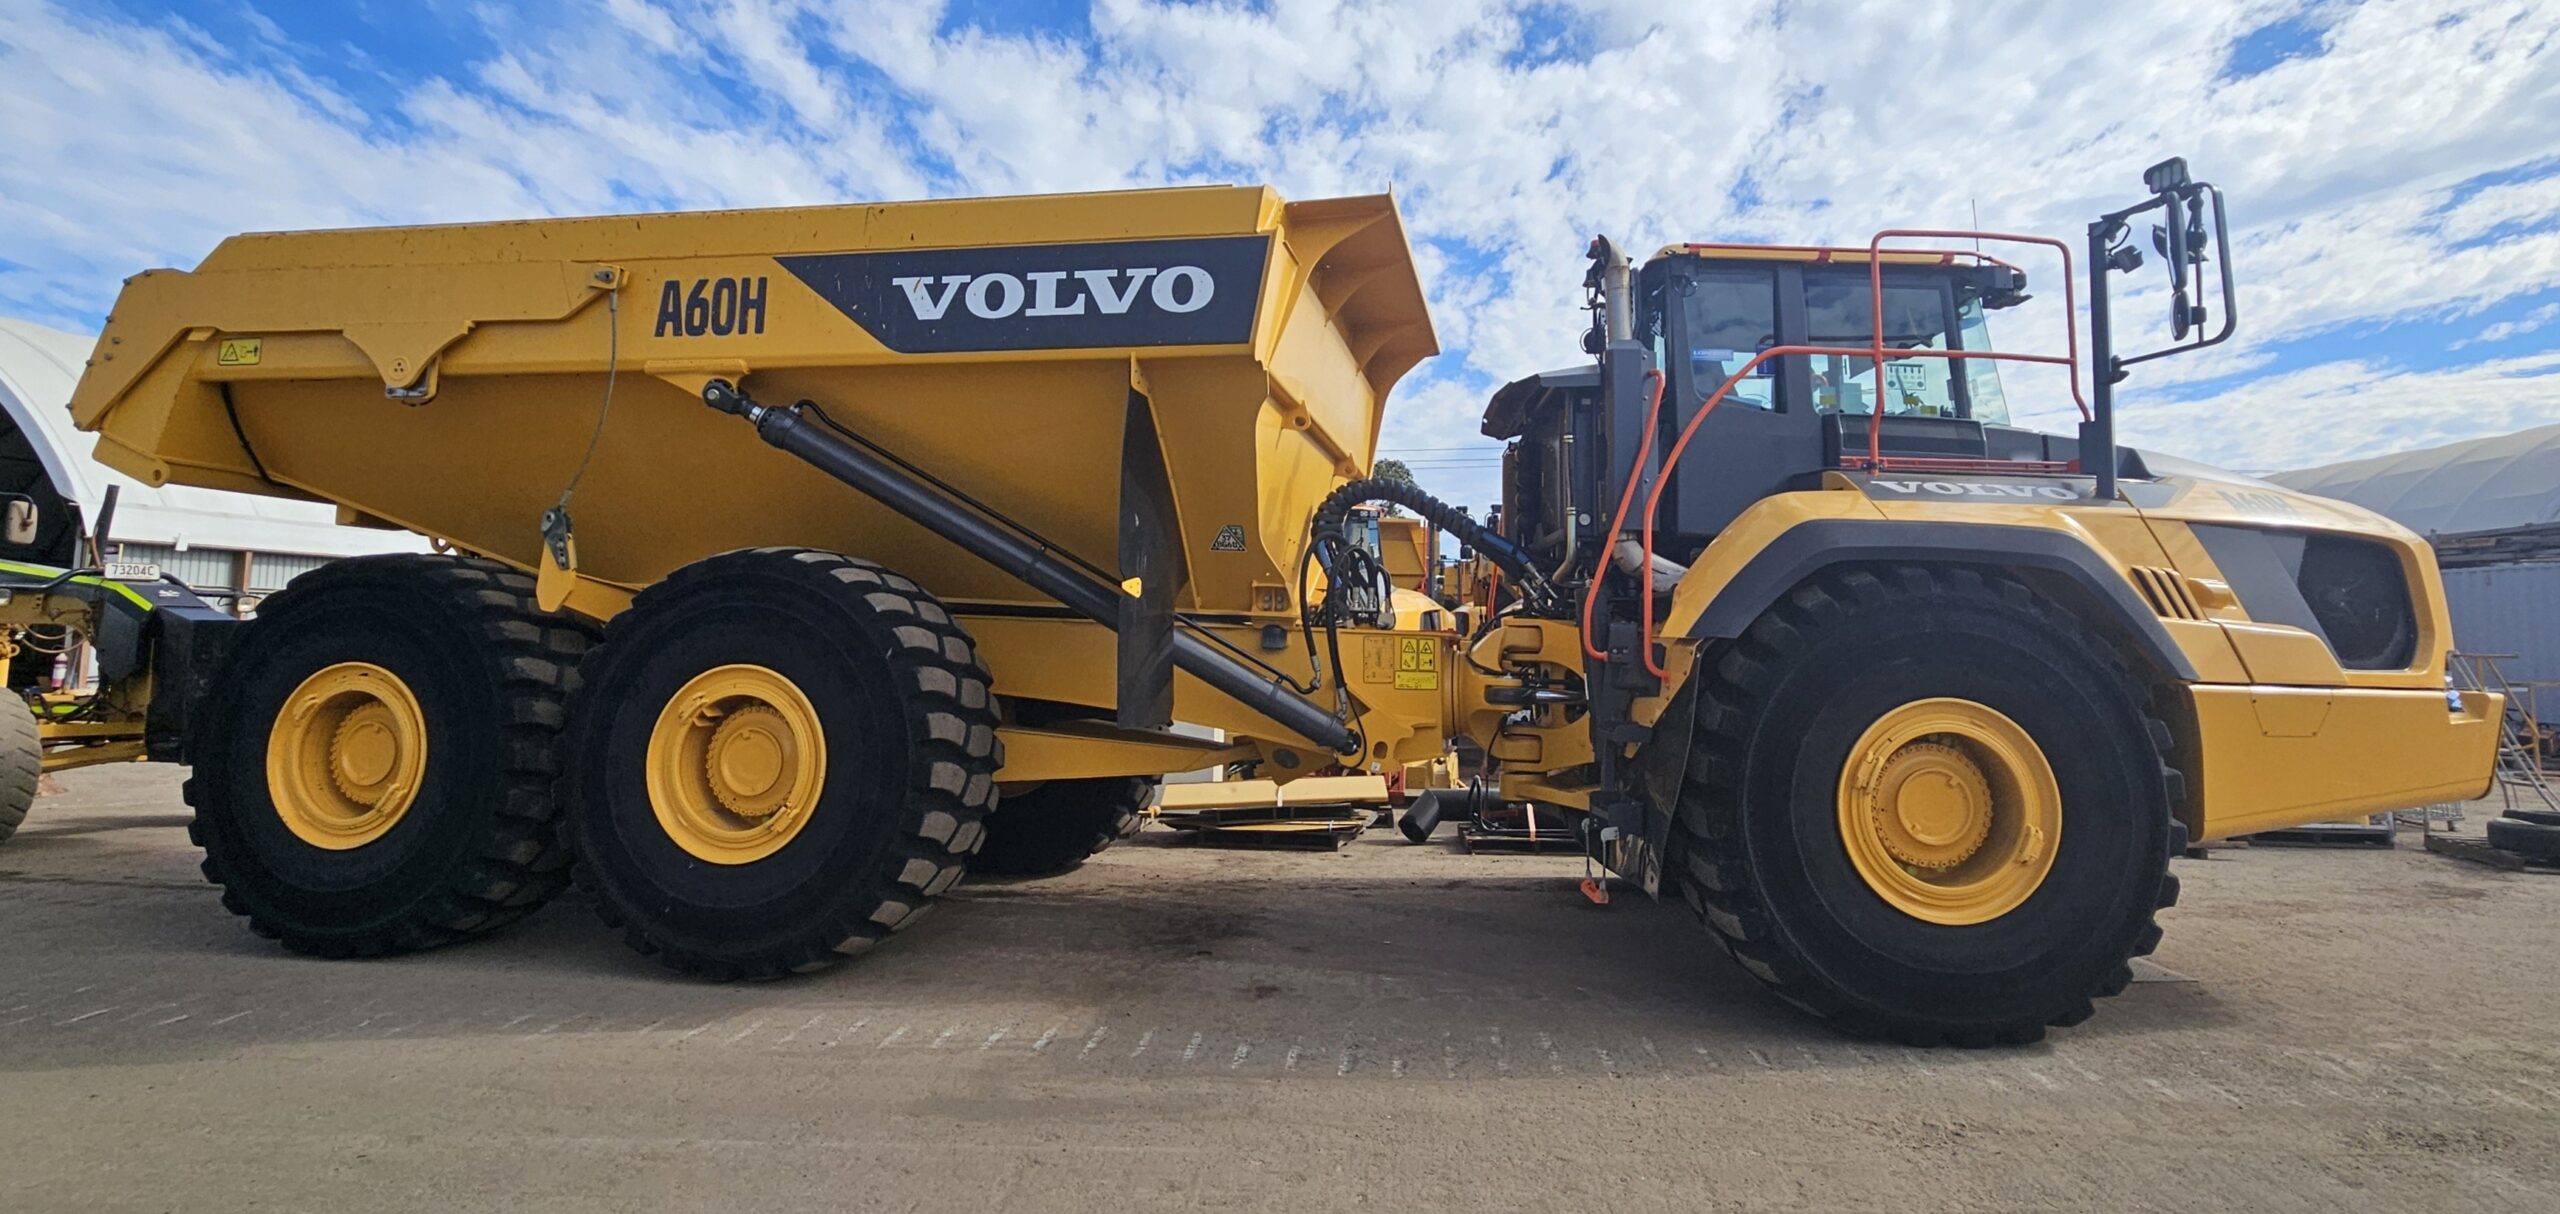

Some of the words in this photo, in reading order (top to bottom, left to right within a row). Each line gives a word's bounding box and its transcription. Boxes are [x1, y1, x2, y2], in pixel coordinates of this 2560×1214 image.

[654, 276, 768, 337] A60H
[892, 265, 1215, 320] VOLVO
[1869, 480, 2079, 500] VOLVO
[111, 564, 155, 576] 73204C
